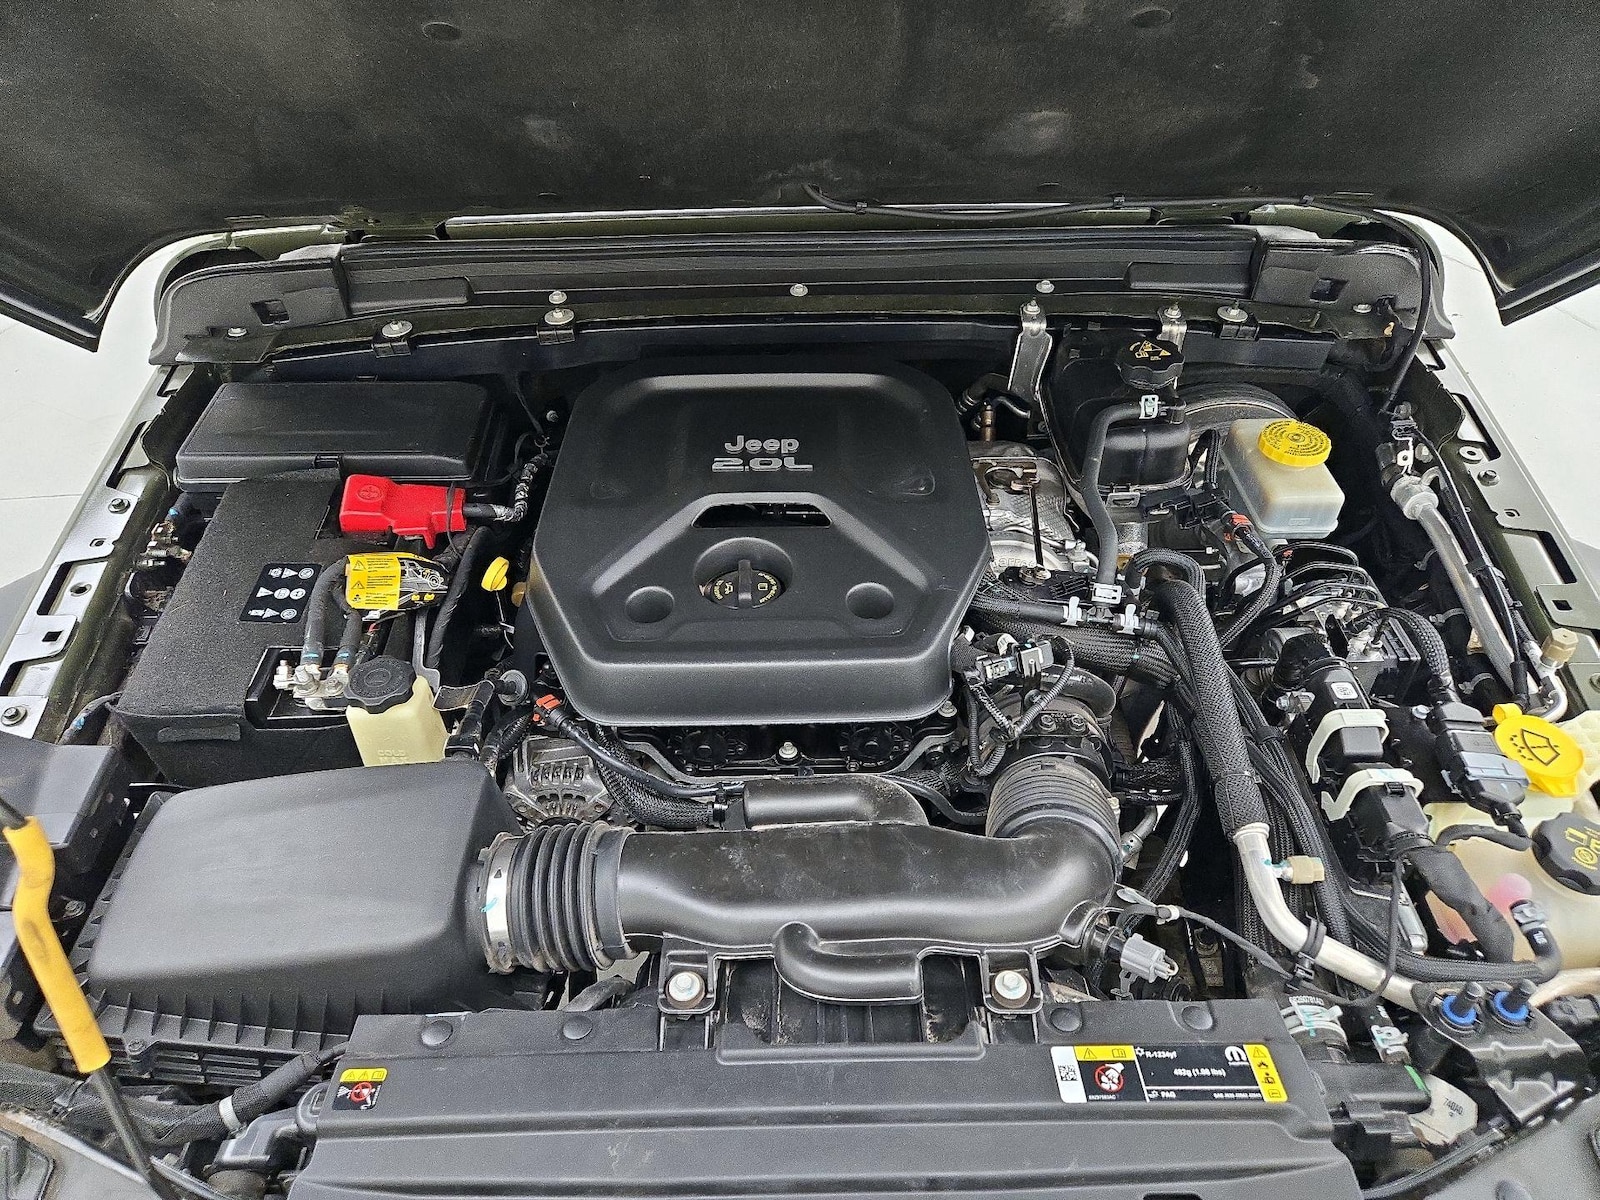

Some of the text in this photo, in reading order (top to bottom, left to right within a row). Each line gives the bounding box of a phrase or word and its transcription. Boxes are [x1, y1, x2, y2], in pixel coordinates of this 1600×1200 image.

[724, 435, 800, 456] Jeep
[711, 457, 814, 473] 2.0L
[378, 749, 406, 758] COLD
